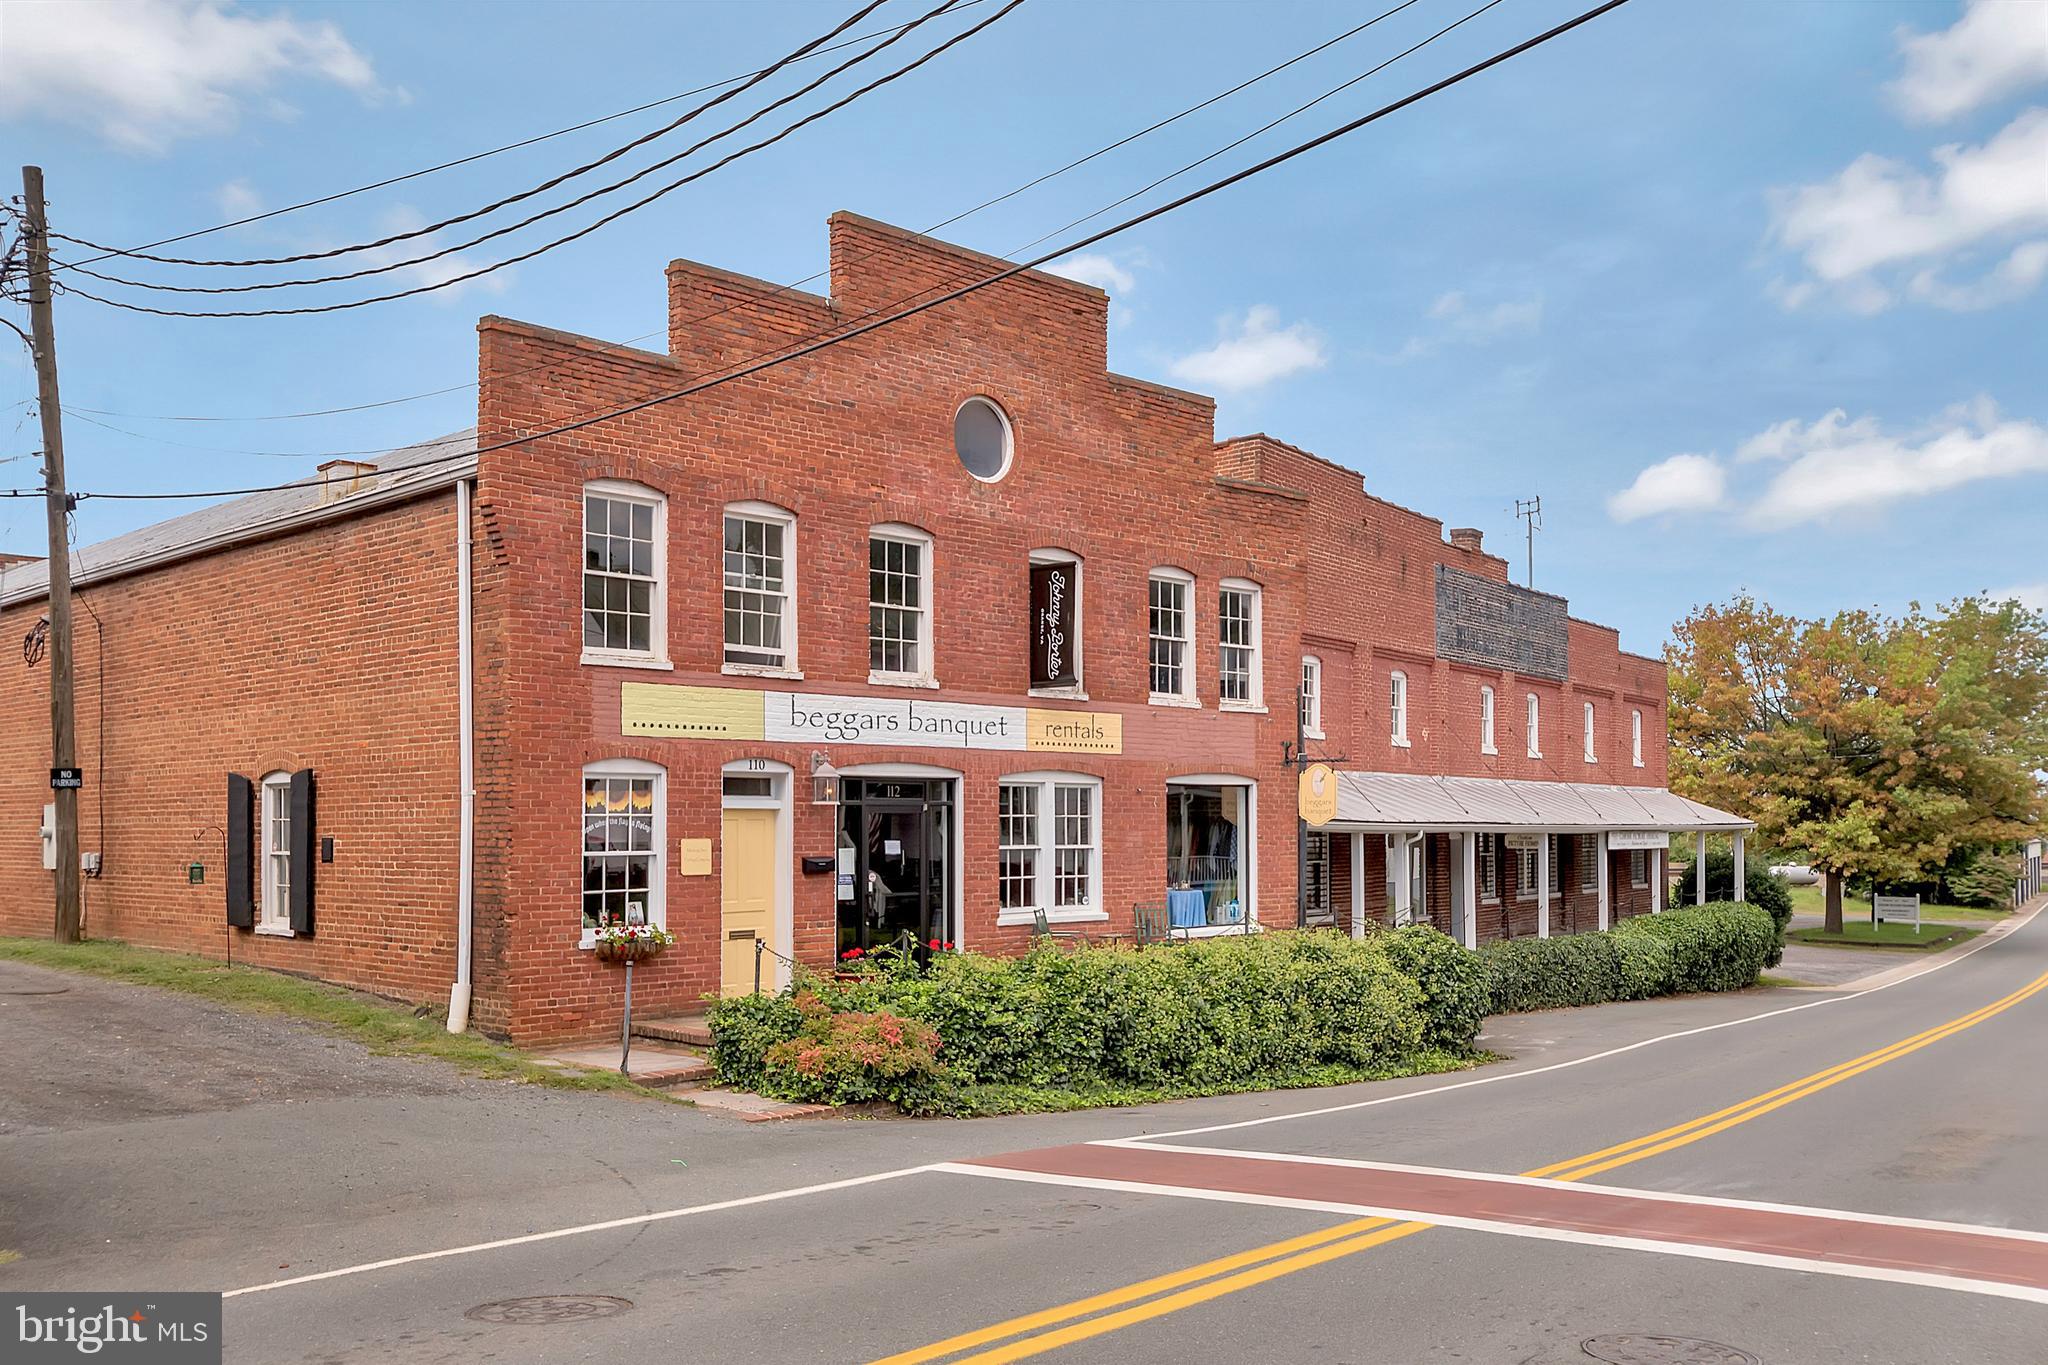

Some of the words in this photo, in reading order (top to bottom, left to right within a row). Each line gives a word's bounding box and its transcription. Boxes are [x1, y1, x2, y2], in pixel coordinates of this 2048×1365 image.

[1046, 570, 1066, 628] Johnny
[1047, 627, 1064, 680] Porter
[790, 695, 900, 742] beggars
[908, 701, 1009, 747] banquet
[1045, 714, 1105, 741] rentals
[748, 759, 766, 771] 110
[52, 779, 81, 787] PARKING
[887, 785, 901, 798] 112
